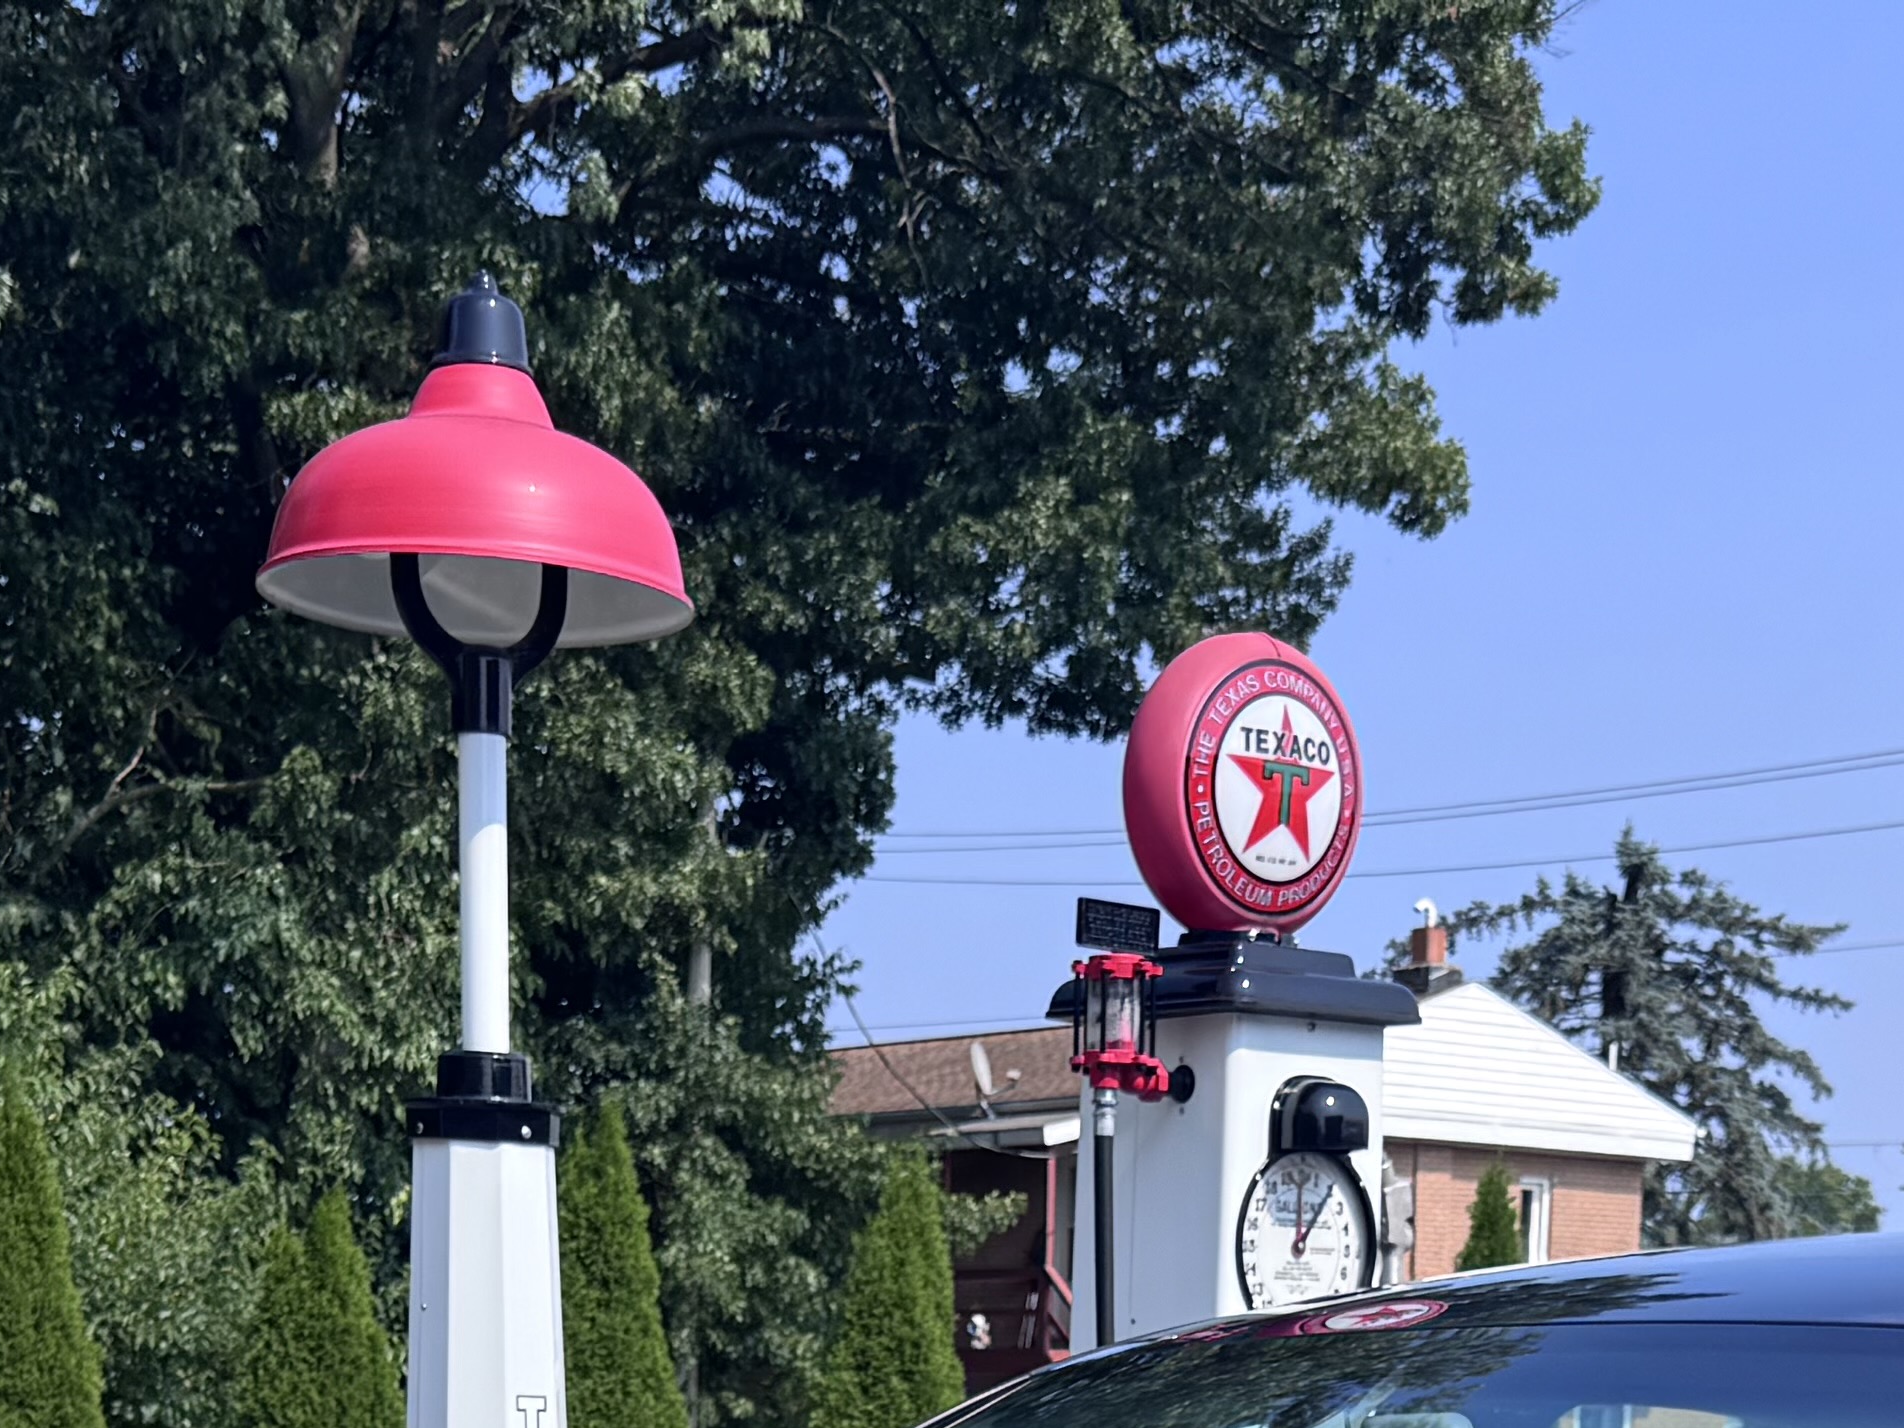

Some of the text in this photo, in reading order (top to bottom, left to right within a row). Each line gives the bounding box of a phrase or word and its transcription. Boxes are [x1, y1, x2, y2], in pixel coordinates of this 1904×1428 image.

[1192, 731, 1216, 778] THE
[1207, 673, 1260, 726] TEXAS
[1264, 670, 1339, 728] COMPANY
[1240, 727, 1331, 766] TEXACO
[1192, 802, 1274, 905] PETROLEUM
